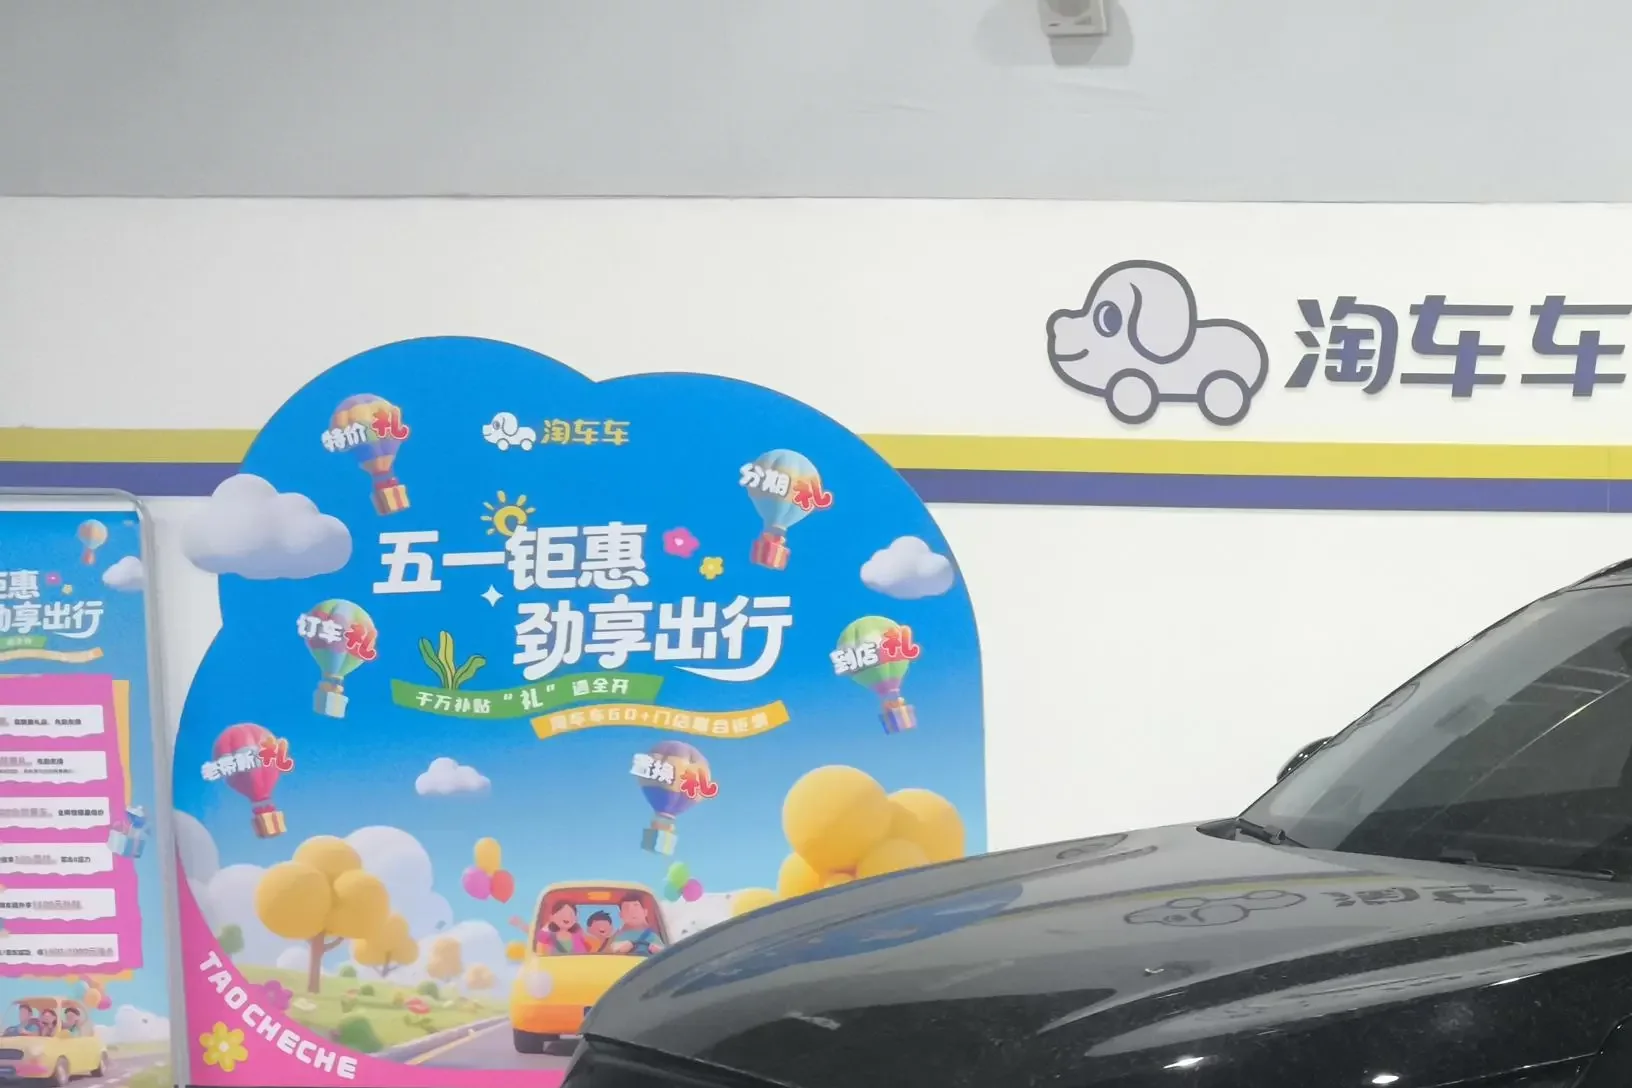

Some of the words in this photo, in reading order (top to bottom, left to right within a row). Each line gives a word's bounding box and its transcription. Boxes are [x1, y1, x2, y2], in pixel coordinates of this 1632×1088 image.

[321, 404, 410, 453] 特价礼
[539, 418, 631, 446] 淘车车
[739, 461, 832, 511] 分期礼
[372, 521, 650, 595] 五一钜惠
[296, 613, 377, 661] 订车礼
[513, 595, 794, 682] 劲享出行
[829, 625, 920, 675] 到店礼
[200, 950, 358, 1080] TAOCHECHE
